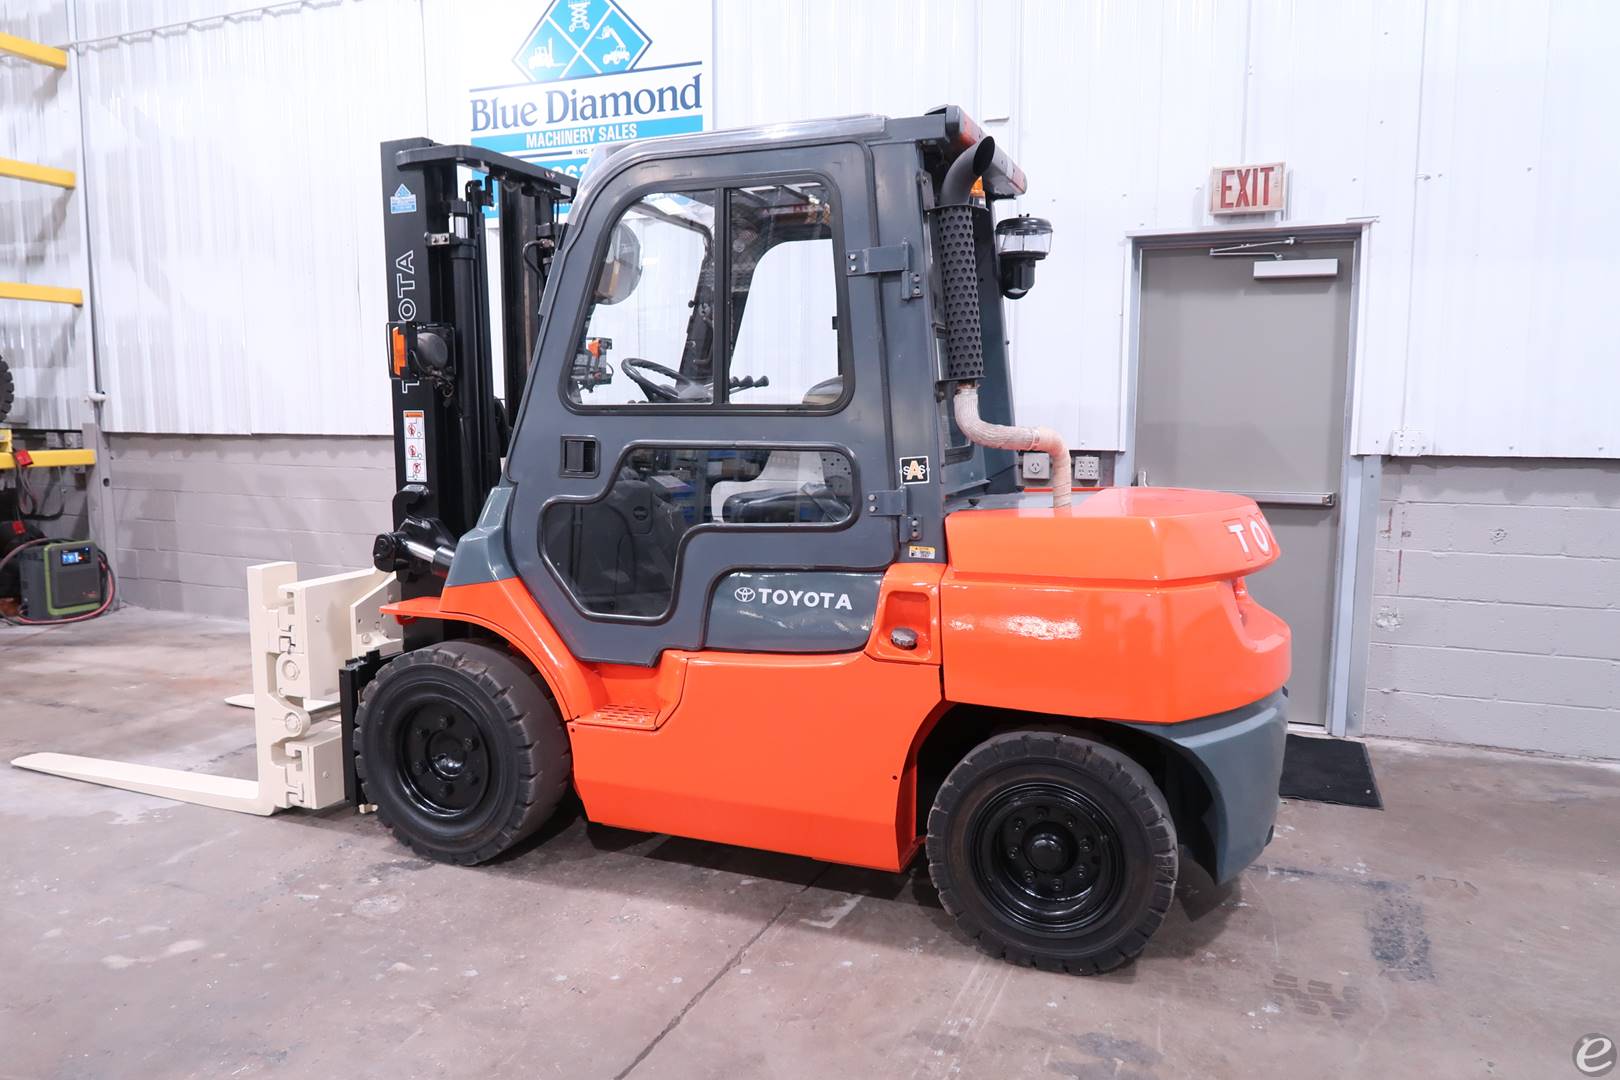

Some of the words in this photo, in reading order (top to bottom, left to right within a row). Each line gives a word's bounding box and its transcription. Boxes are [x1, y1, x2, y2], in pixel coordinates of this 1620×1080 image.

[470, 97, 538, 132] Blue
[545, 73, 703, 124] Diamond
[526, 128, 595, 149] MACHINERY
[598, 123, 638, 141] SALES
[1220, 166, 1274, 208] EXIT
[758, 588, 853, 610] TOYOTA
